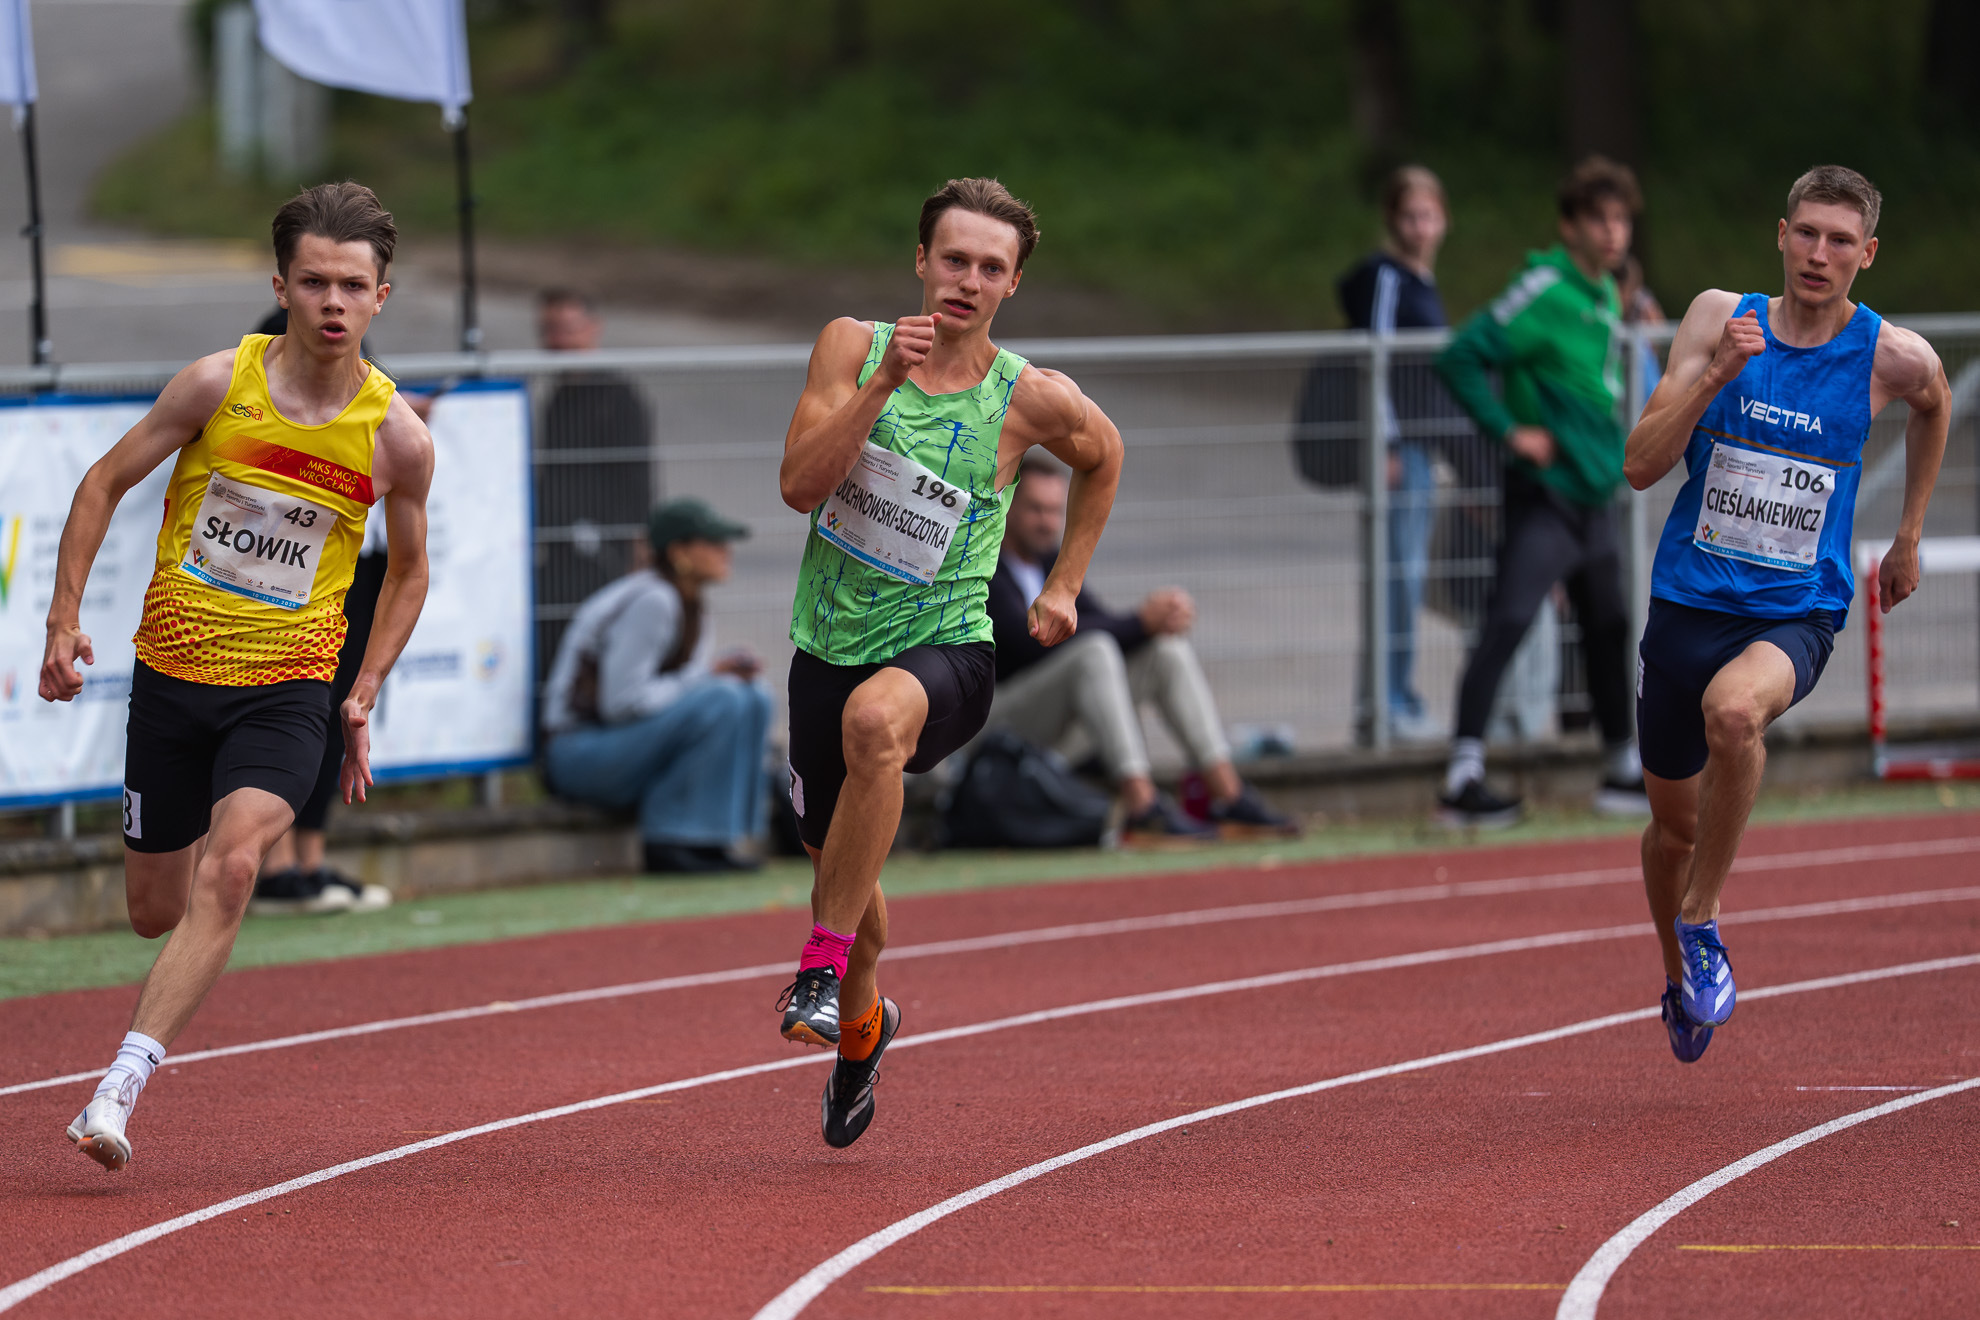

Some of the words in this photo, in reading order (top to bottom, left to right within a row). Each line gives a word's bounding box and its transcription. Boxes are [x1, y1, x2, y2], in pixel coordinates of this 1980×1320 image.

[1740, 396, 1822, 434] VECTRA
[299, 467, 356, 495] WROCŁAW
[307, 460, 331, 475] MKS
[332, 468, 359, 485] MOS
[1780, 467, 1825, 493] 106
[911, 474, 959, 508] 196
[284, 506, 318, 528] 43
[1706, 487, 1822, 532] CIEŚLAKIEWICZ
[202, 516, 311, 569] SŁOWIK
